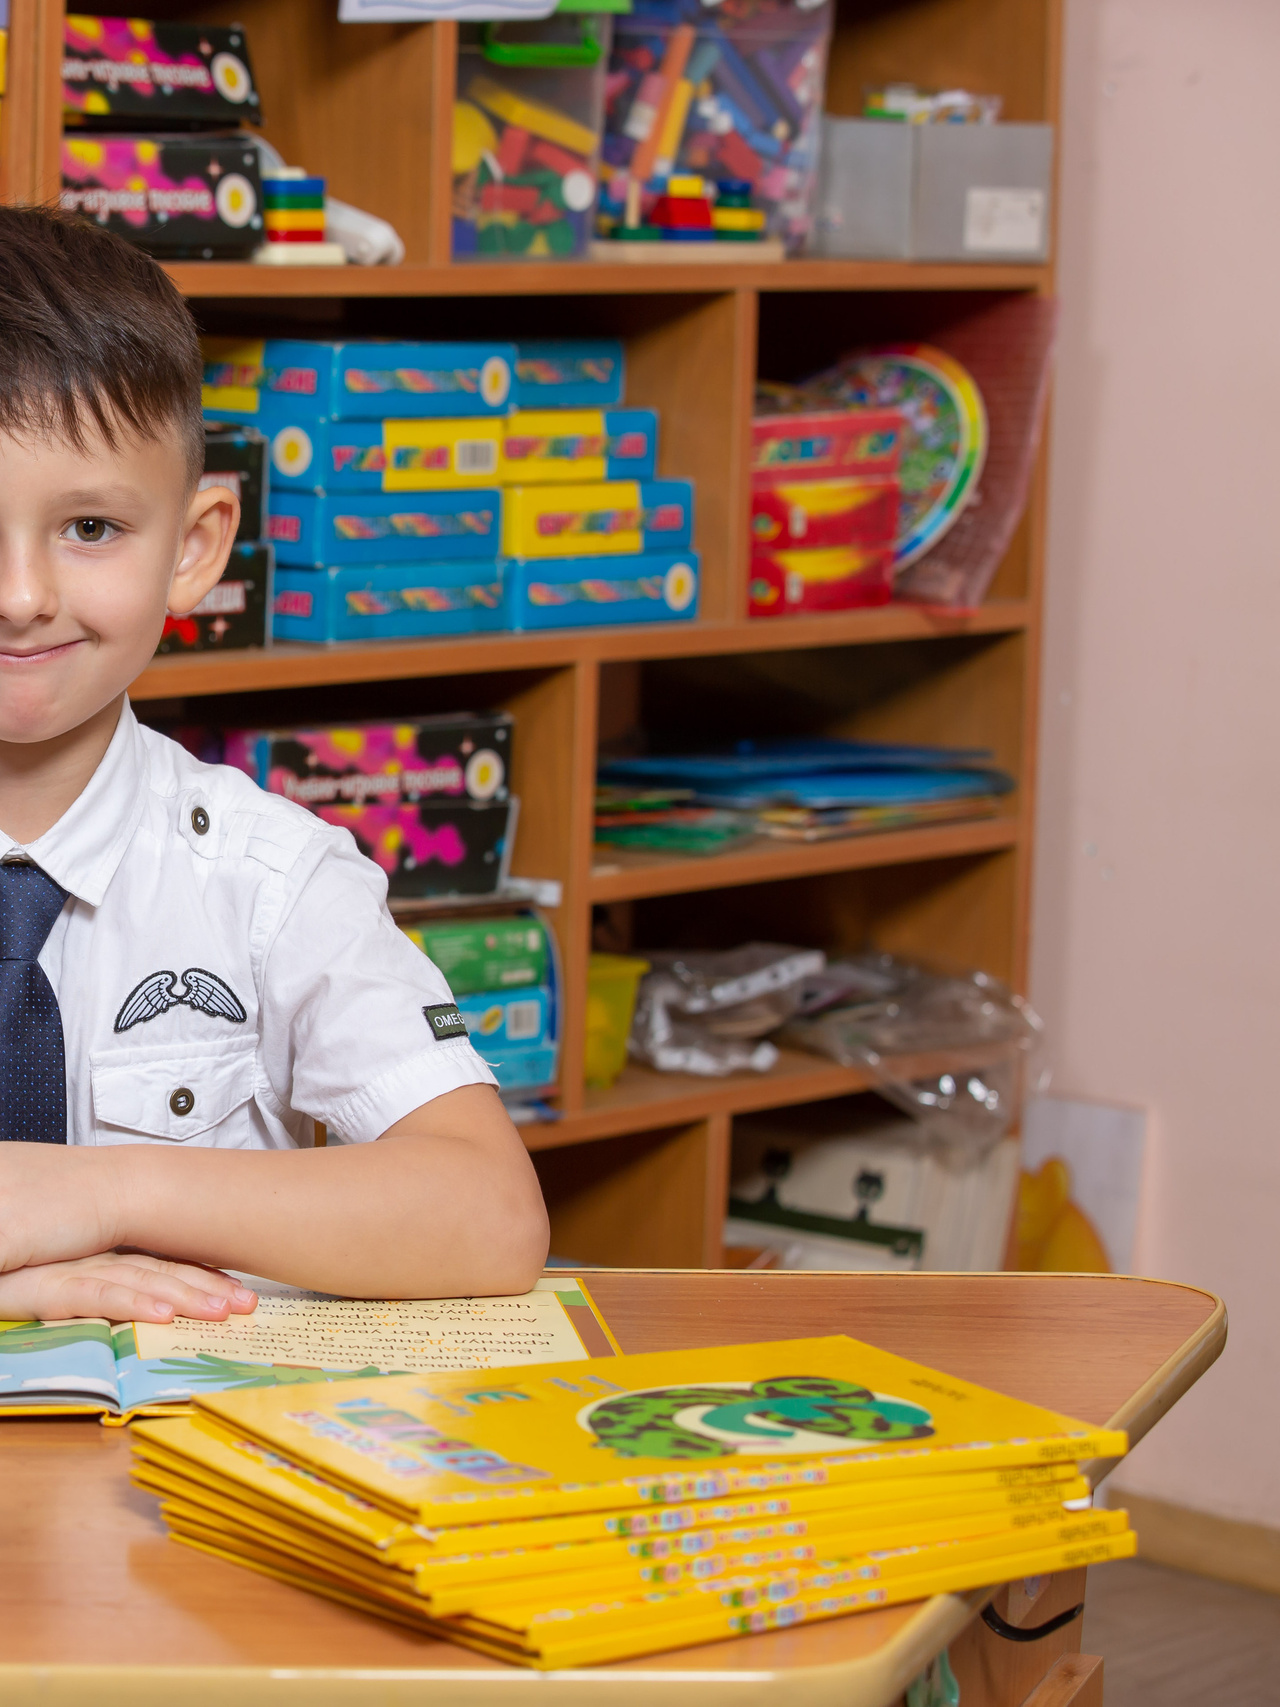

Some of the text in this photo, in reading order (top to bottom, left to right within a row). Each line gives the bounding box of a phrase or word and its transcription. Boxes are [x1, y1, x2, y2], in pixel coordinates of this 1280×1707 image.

[434, 1013, 465, 1028] OMEG
[339, 1306, 408, 1314] чтобы
[262, 1311, 389, 1319] держались
[225, 1329, 310, 1339] покажу
[282, 1325, 381, 1334] увидите,
[365, 1337, 444, 1346] Денис.
[454, 1338, 550, 1346] крикнул
[298, 1341, 427, 1353] Держитесь
[439, 1346, 532, 1355] Вперёд!
[302, 1349, 372, 1358] помог
[405, 1354, 491, 1362] Дениса
